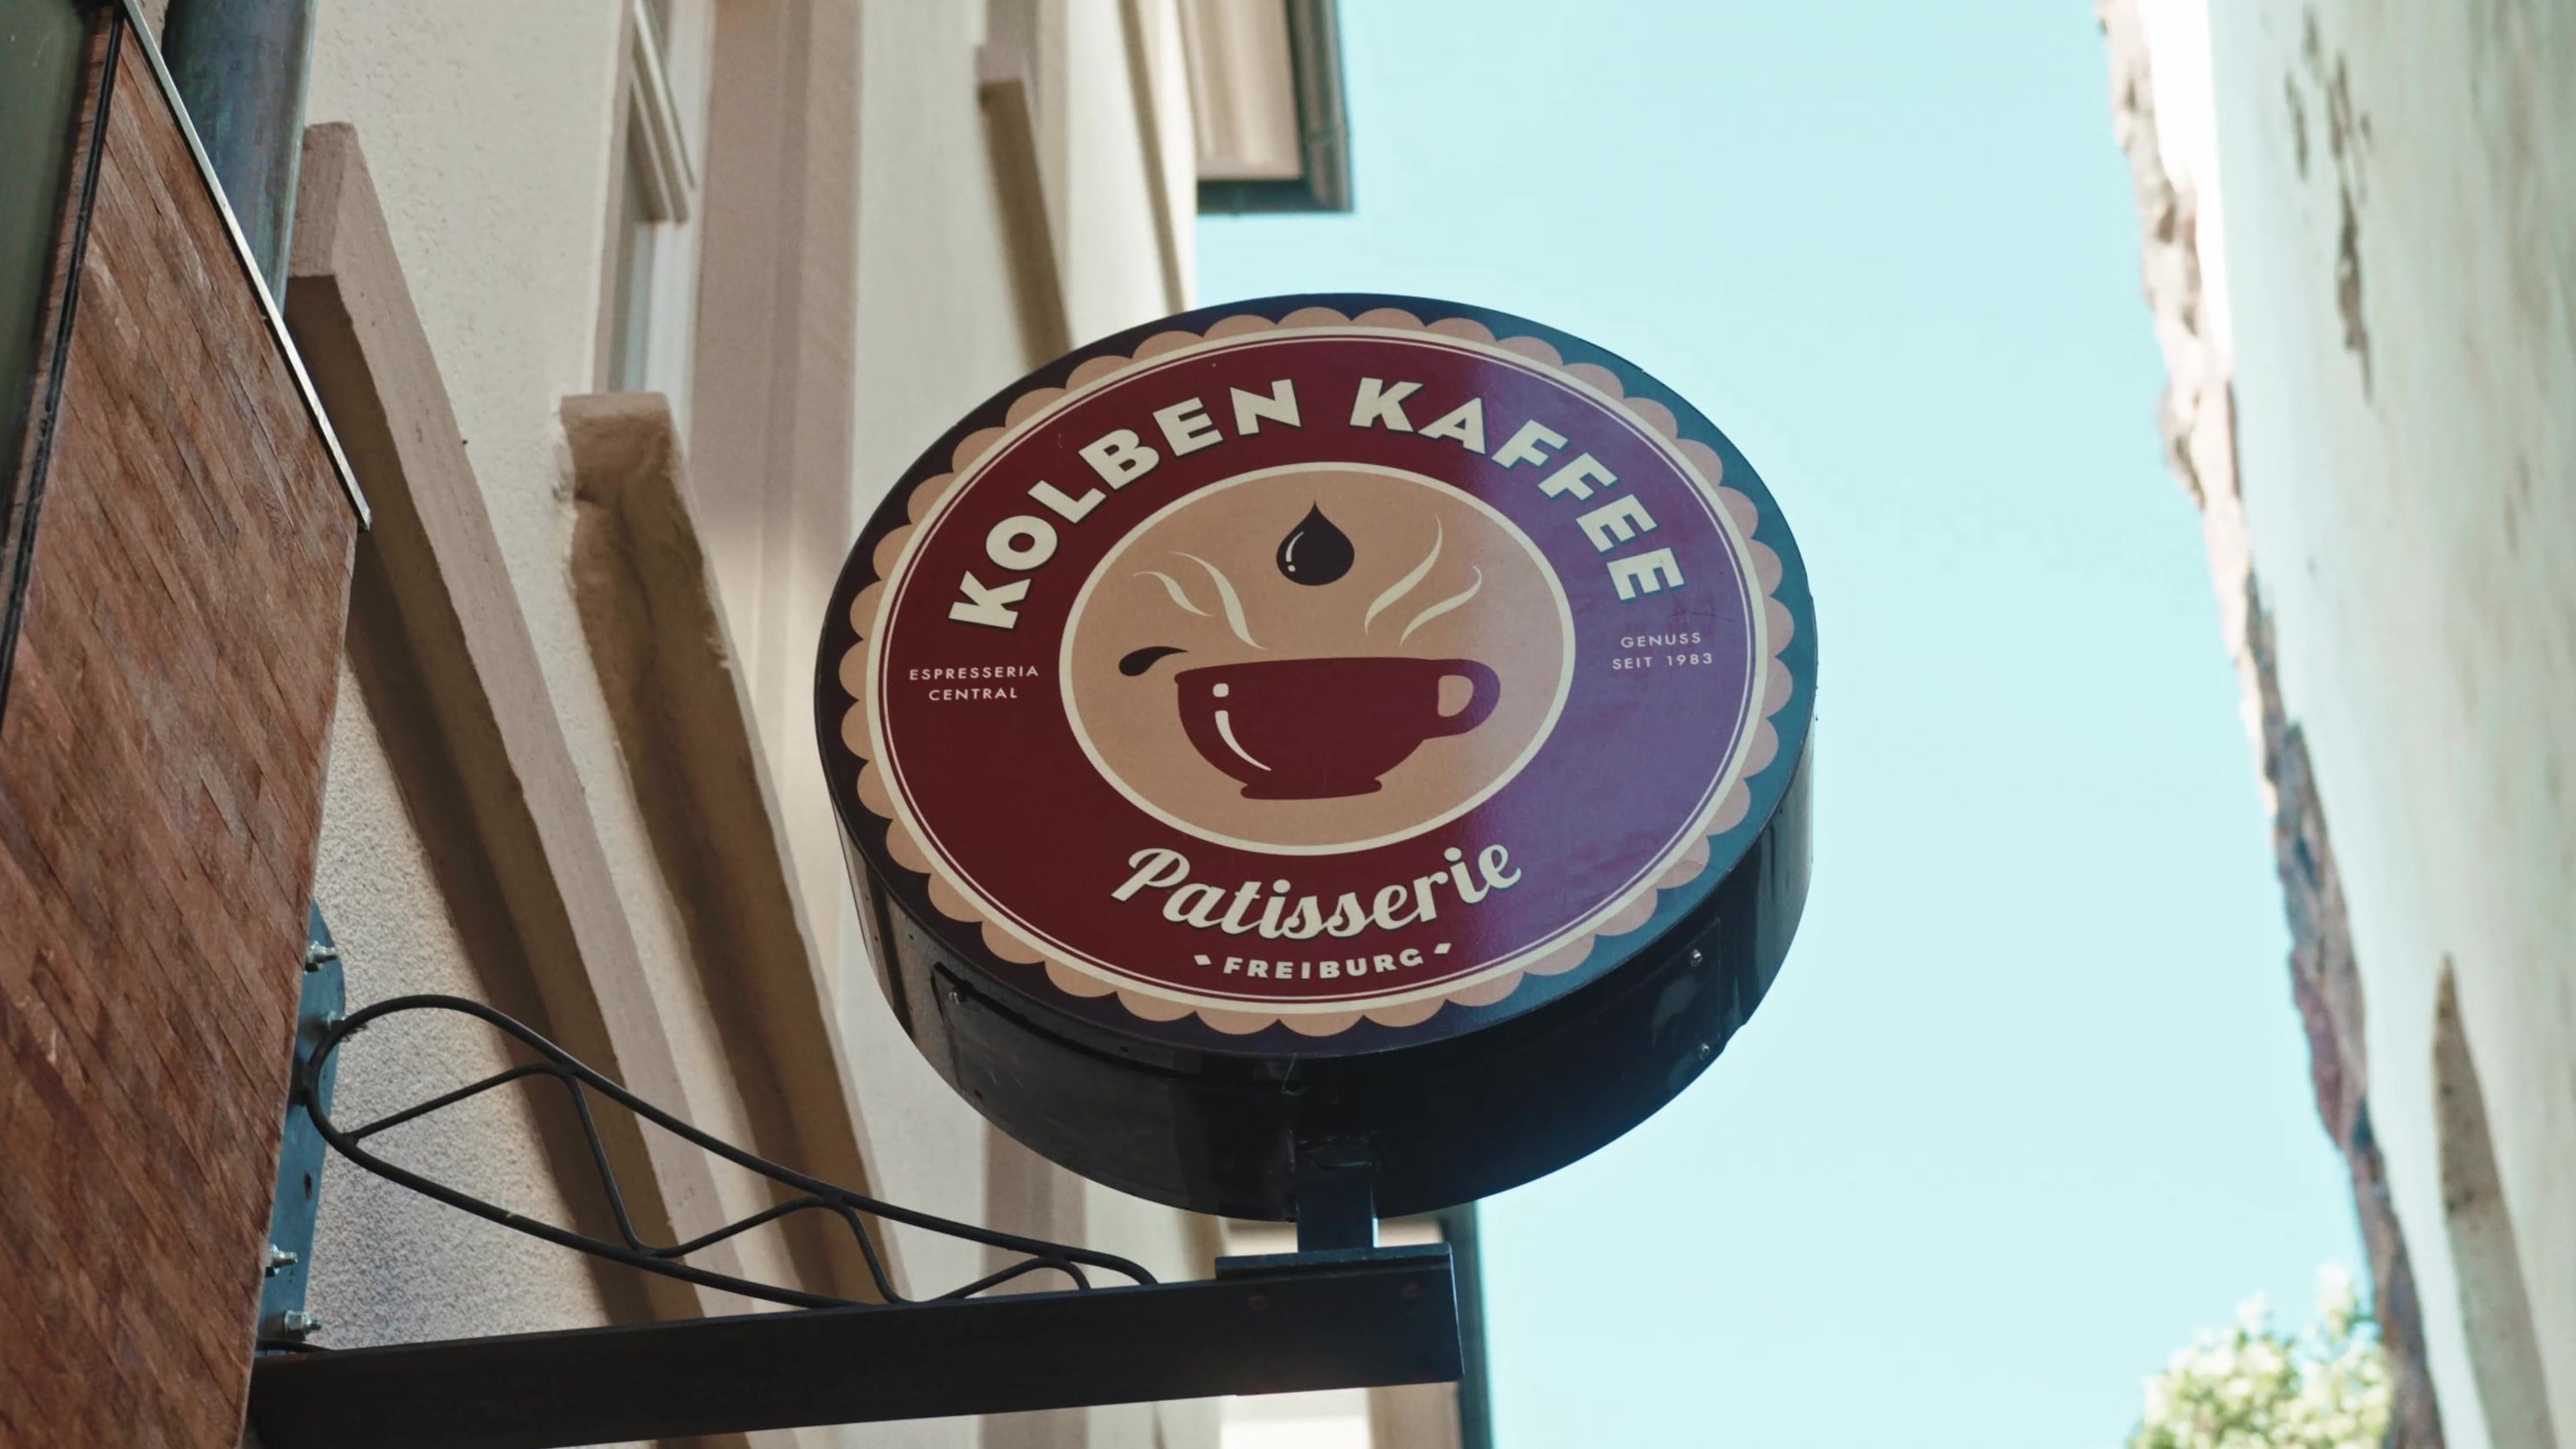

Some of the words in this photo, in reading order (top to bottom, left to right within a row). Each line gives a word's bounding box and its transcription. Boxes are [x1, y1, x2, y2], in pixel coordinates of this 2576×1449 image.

[948, 378, 1301, 629] KOLBEN
[1349, 377, 1685, 602] KAFFEE
[1620, 632, 1702, 647] GENUSS
[1612, 656, 1652, 670] SEIT
[1667, 653, 1713, 667] 1983
[909, 665, 1040, 681] ESPRESSERIA
[928, 687, 1019, 701] CENTRAL
[1111, 844, 1523, 940] Patisserie
[1224, 948, 1424, 979] FREIBURG
